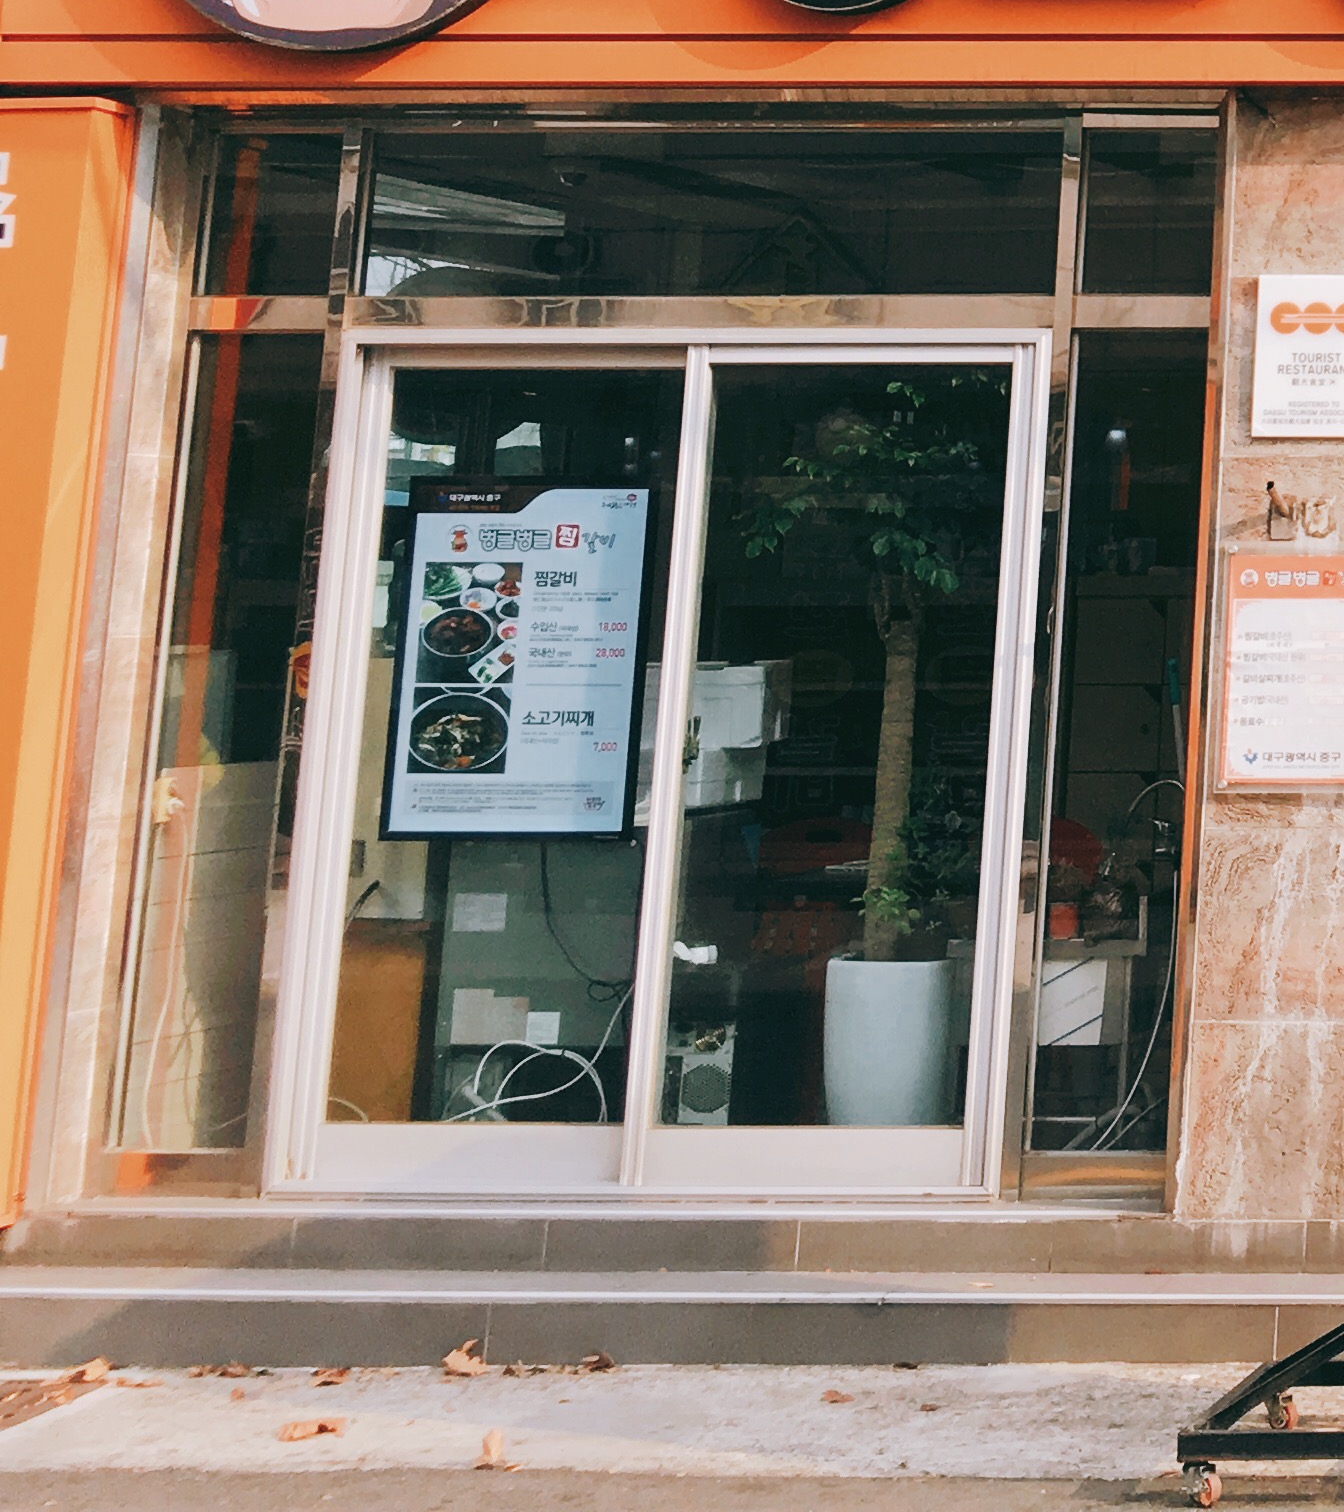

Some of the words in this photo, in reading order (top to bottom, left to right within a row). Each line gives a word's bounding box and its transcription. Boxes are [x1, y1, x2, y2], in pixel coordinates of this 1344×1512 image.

[1291, 352, 1342, 363] TOURIST
[478, 528, 553, 552] 벙글벙글
[534, 571, 578, 588] 찜갈비
[598, 622, 628, 633] 18,000
[521, 710, 595, 727] 소고기찌개
[592, 741, 618, 753] 7,000
[1262, 752, 1317, 763] 대구광역시
[1319, 752, 1342, 762] 중구
